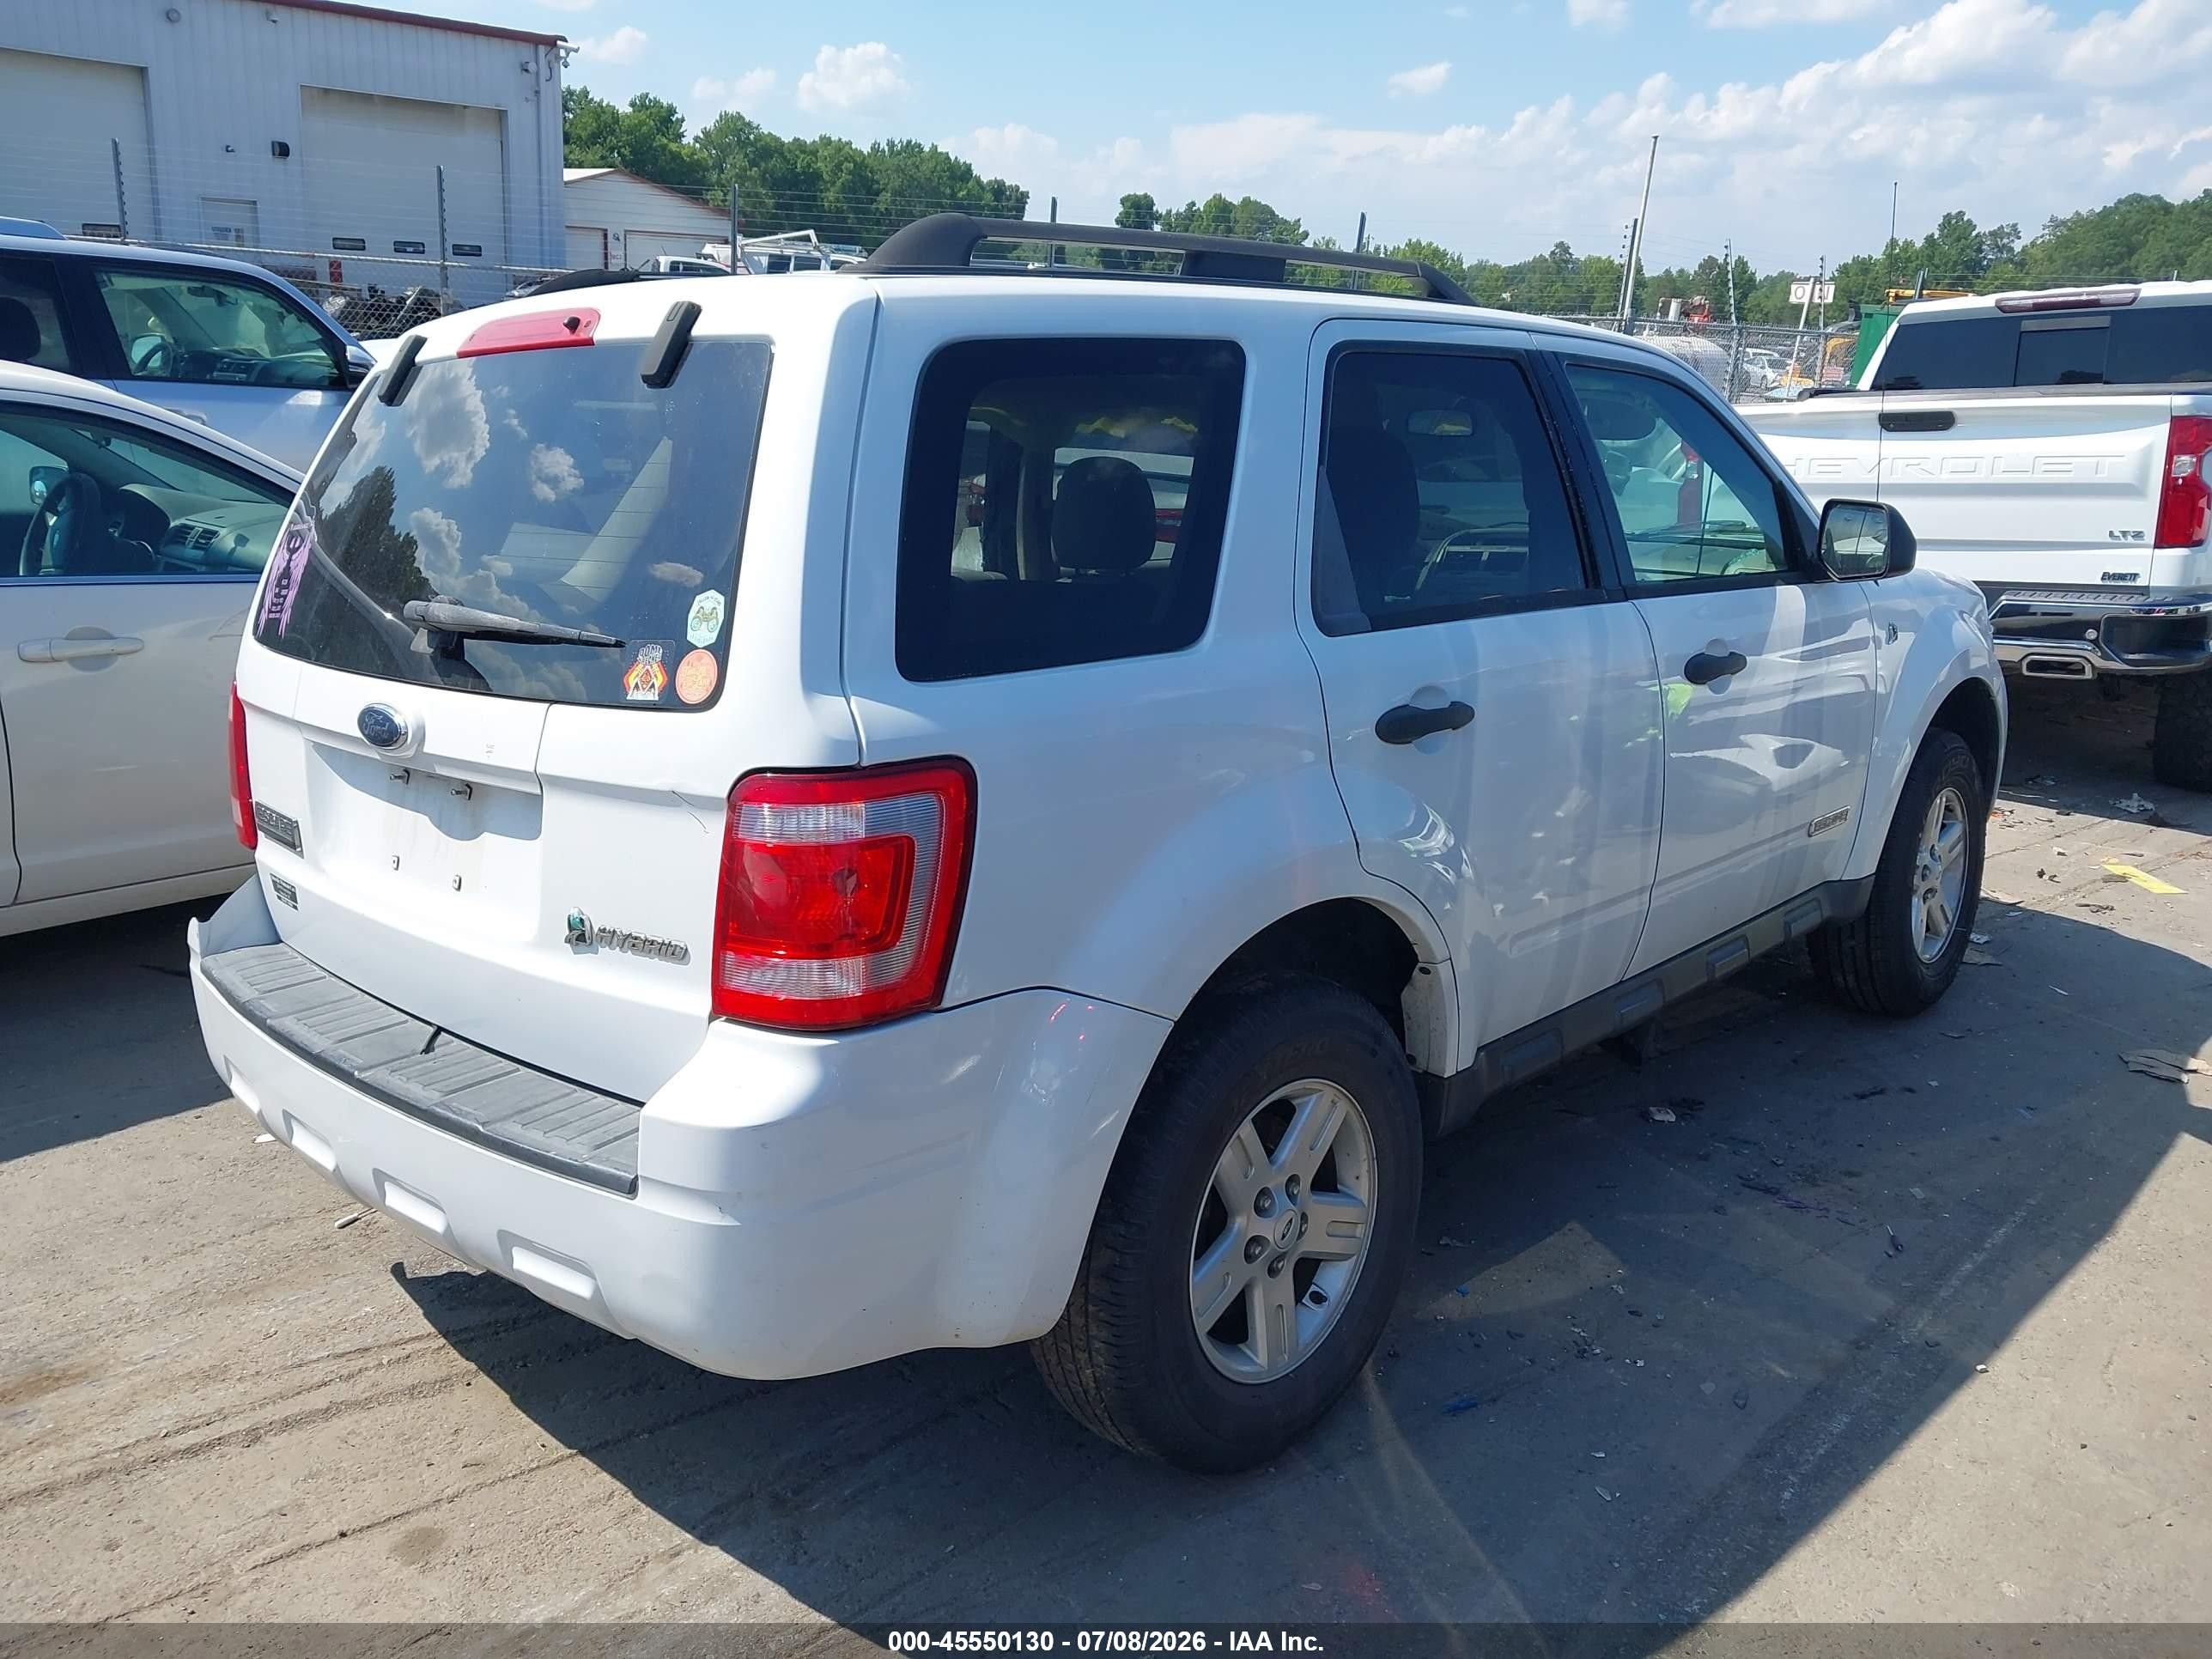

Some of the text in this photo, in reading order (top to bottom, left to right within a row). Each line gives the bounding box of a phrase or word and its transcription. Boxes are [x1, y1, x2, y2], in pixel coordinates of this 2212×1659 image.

[1784, 455, 2125, 477] HEVROLET
[2108, 530, 2145, 541] LTZ
[2100, 571, 2141, 584] EVERETT
[362, 711, 391, 738] Ford
[596, 926, 690, 963] HYBRID
